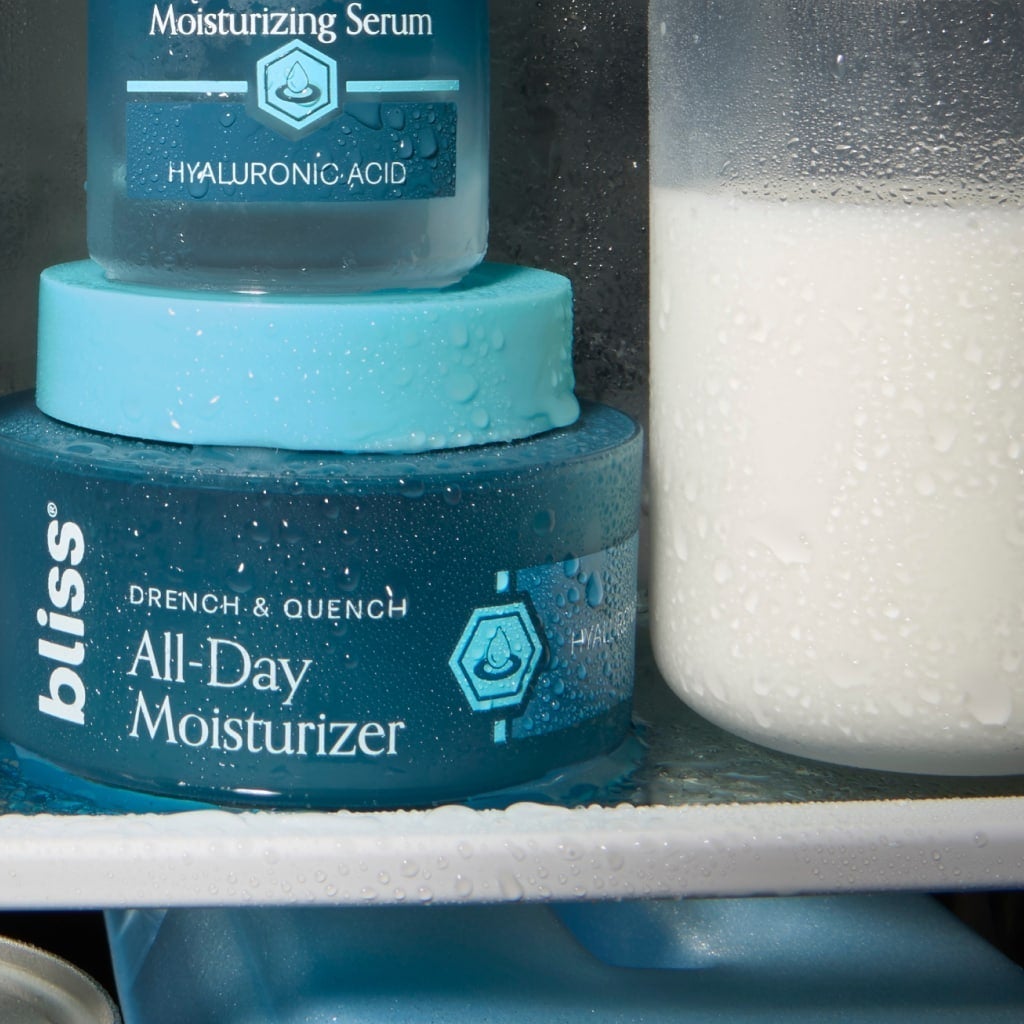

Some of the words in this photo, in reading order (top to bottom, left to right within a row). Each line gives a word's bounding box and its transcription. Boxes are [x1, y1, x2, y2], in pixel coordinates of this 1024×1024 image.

[149, 2, 337, 44] Moisturizing
[346, 2, 433, 36] Serum
[168, 161, 338, 186] HYALURONIC
[347, 161, 407, 186] ACID
[129, 585, 239, 616] DRENCH
[254, 597, 269, 617] &
[284, 592, 407, 620] QUENCH
[126, 629, 312, 706] All-Day
[128, 689, 405, 757] Moisturizer
